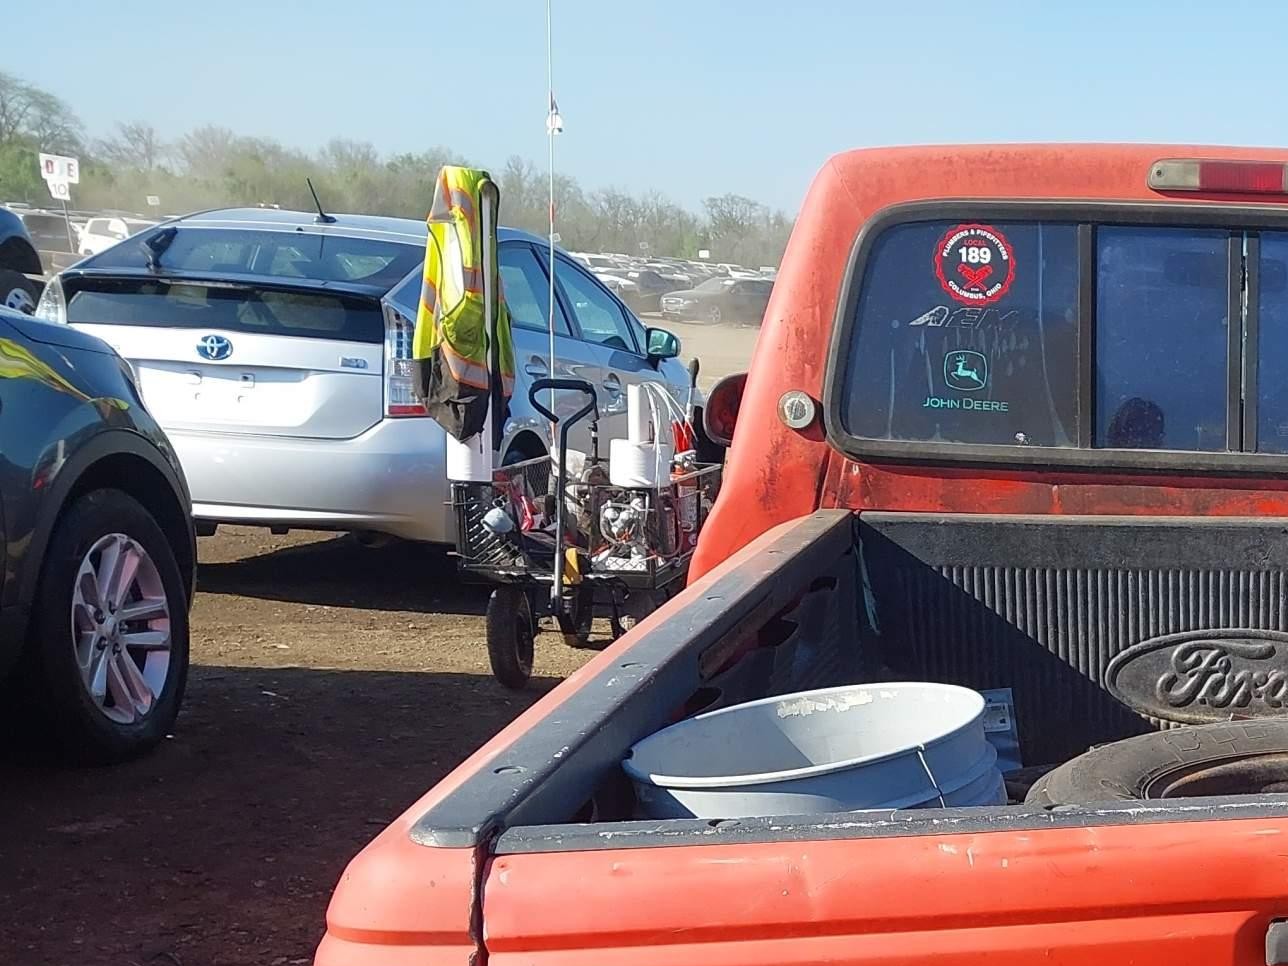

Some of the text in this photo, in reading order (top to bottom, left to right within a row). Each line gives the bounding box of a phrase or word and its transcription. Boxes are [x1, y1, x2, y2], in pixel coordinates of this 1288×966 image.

[52, 184, 67, 196] 10
[958, 246, 991, 264] 189
[985, 282, 1002, 297] OHIO
[922, 397, 1009, 412] JOHN DEERE
